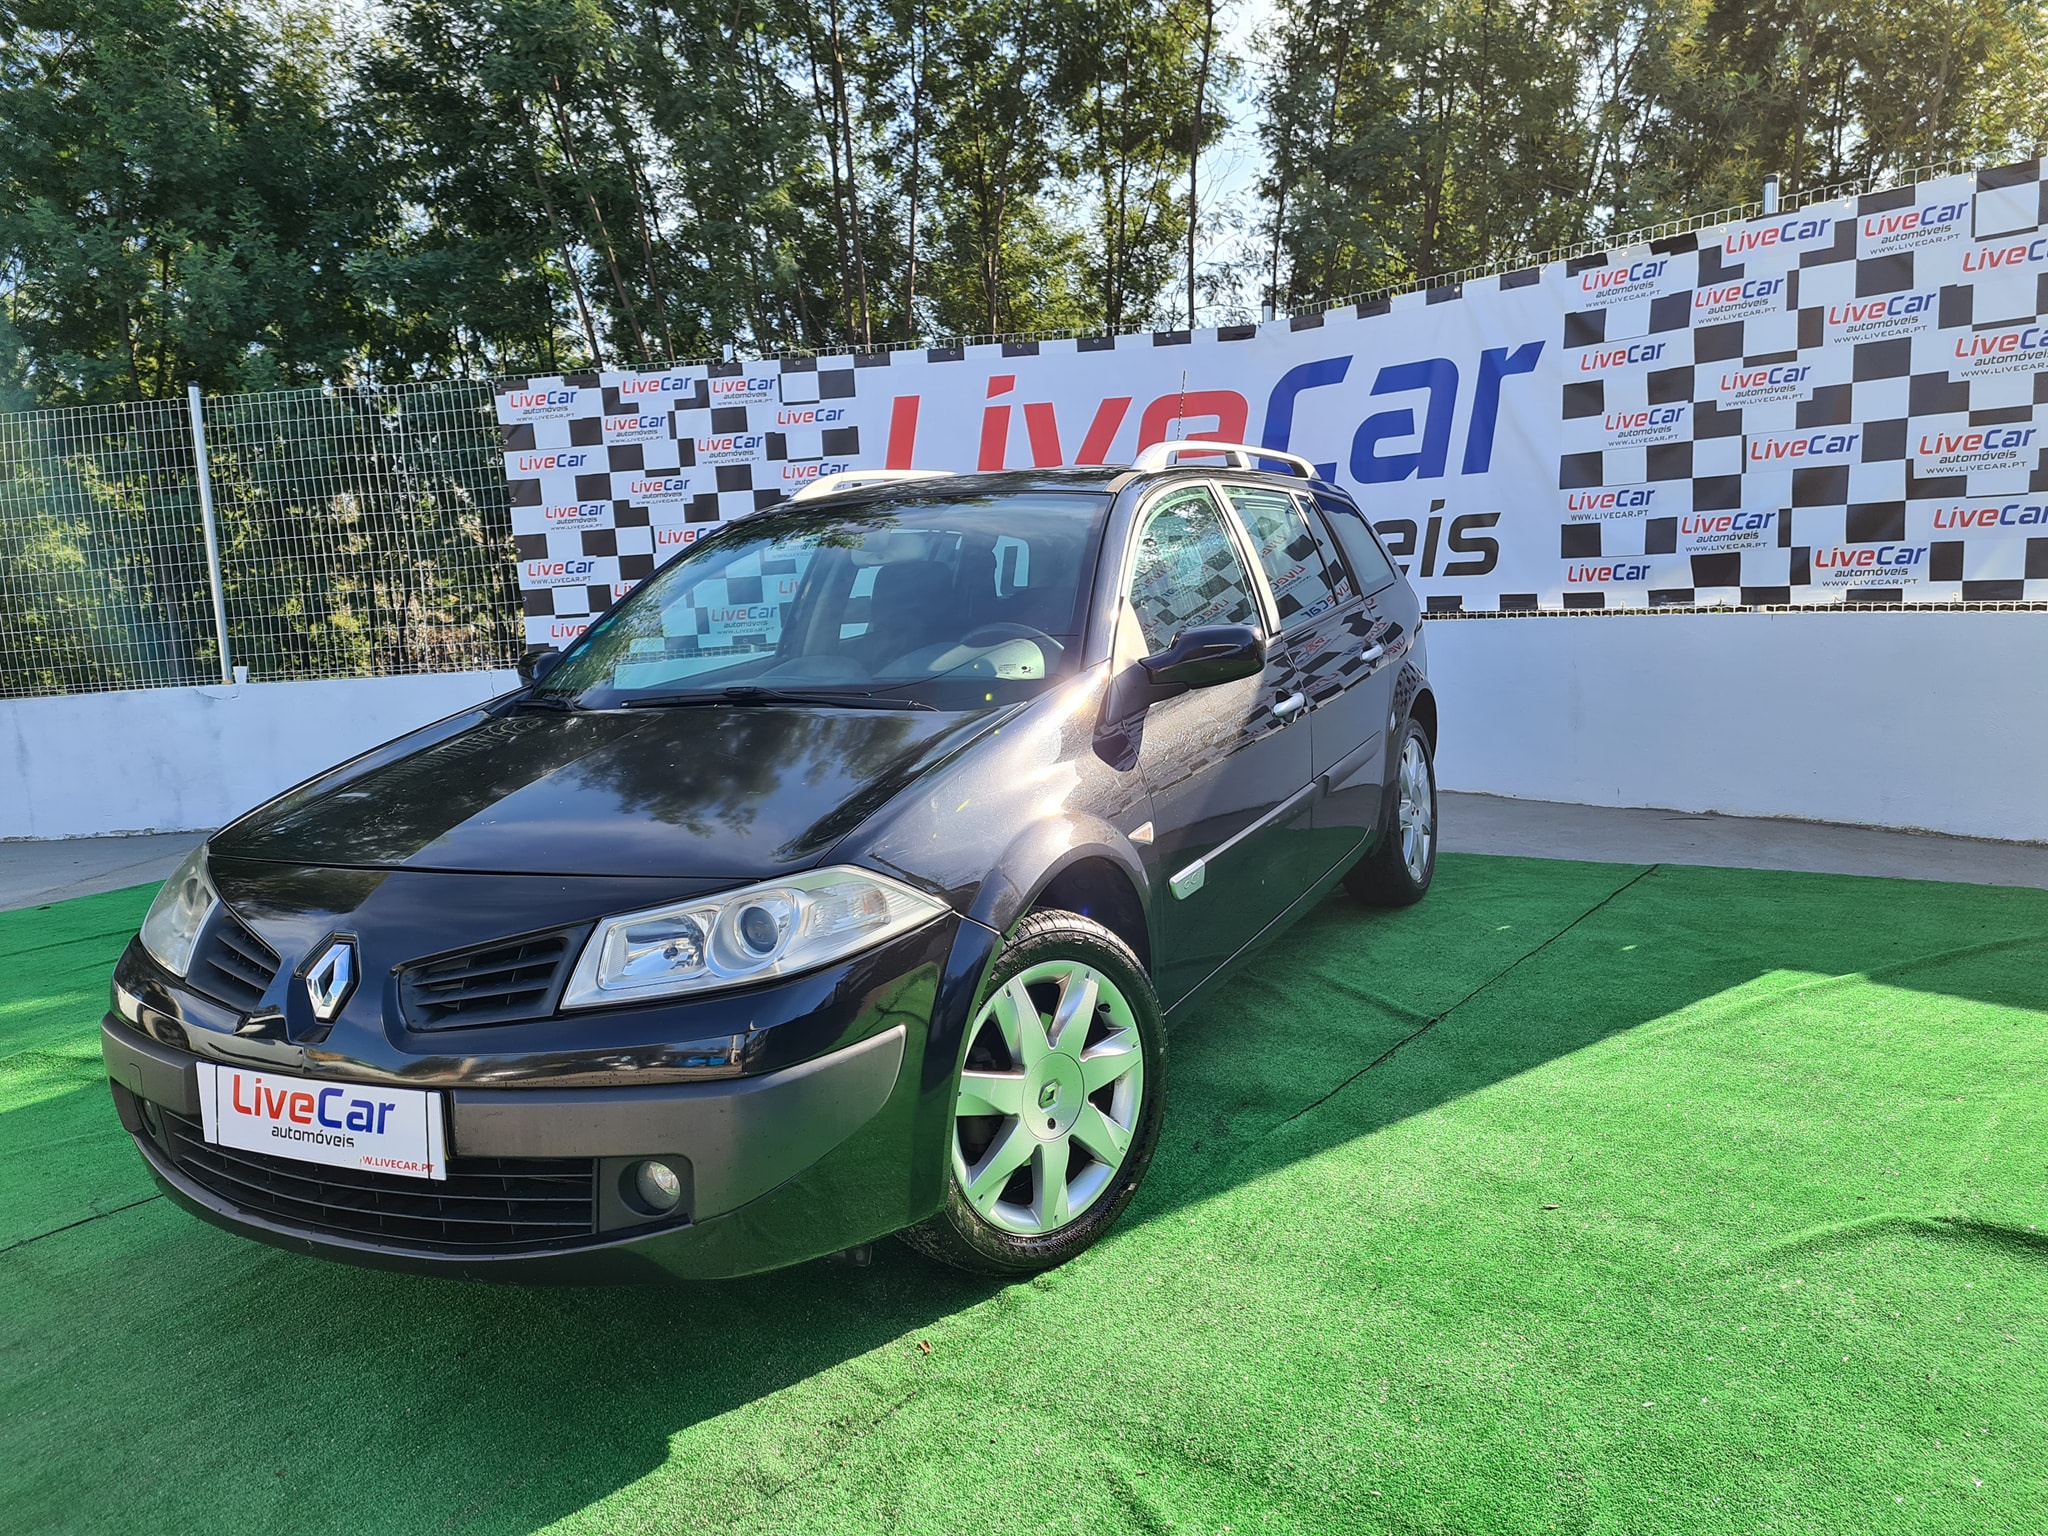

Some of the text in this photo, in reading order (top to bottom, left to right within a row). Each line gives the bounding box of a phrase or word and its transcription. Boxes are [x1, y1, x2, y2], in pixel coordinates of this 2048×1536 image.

[1865, 201, 1968, 237] LiveCar
[1726, 217, 1831, 254] LiveCar
[1881, 223, 1951, 245] automóveis
[1869, 233, 1960, 255] WWW.LIVECAR.PT
[1962, 239, 2048, 272] LiveC
[1582, 259, 1668, 291] LiveCar
[1596, 280, 1654, 299] automóveis
[1695, 278, 1784, 308] LiveCar
[1585, 289, 1661, 308] WWW.LIVECAR.PT
[1708, 298, 1769, 315] automóveis
[1698, 307, 1777, 324] WWW.LIVECAR.PT
[1829, 293, 1936, 325] LiveCar
[1846, 315, 1918, 334] automóveis
[1833, 325, 1927, 344] WWW.LIVECAR.PT
[1580, 342, 1666, 371] LiveCar
[1974, 349, 2048, 367] automóvei
[1961, 362, 2048, 378] WWW.LIVECAR.
[622, 377, 692, 394] LiveCar
[712, 378, 776, 393] LiveCar
[1721, 366, 1811, 391] LiveCar
[510, 390, 577, 408] LiveCar
[723, 391, 767, 400] automóveis
[1735, 384, 1796, 398] automóveis
[1725, 393, 1804, 407] WWW.LIVECAR.PT
[515, 412, 576, 422] WWW.LIVECAR.PT
[522, 405, 569, 415] automóveis
[777, 408, 845, 424] LiveCar
[885, 341, 1546, 483] LiveCar
[604, 416, 666, 431] LiveCar
[1604, 406, 1685, 431] LiveCar
[616, 429, 658, 437] automóveis
[1617, 425, 1672, 438] automóveis
[698, 435, 763, 451] LiveCar
[1608, 433, 1679, 447] WWW.LIVECAR.PT
[1750, 434, 1859, 460] LiveCar
[1919, 428, 2037, 455] LiveCar
[519, 453, 587, 471] LiveCar
[702, 457, 760, 465] WWW.LIVECAR.PT
[709, 450, 754, 458] automóveis
[1939, 450, 2017, 465] automóveis
[783, 463, 849, 479] LiveCar
[1926, 461, 2028, 474] WWW.LIVECAR.PT
[631, 479, 690, 493] LiveCar
[642, 491, 682, 499] automóveis
[1568, 489, 1655, 511] LiveCar
[545, 503, 605, 519] LiveCar
[1570, 509, 1649, 522] WWW.LIVECAR.PT
[556, 517, 597, 525] automóveis
[1681, 512, 1775, 534] LiveCar
[658, 528, 713, 544] LiveC
[1696, 530, 1759, 543] automóveis
[1685, 541, 1767, 553] WWW.LIVECAR.PT
[1814, 546, 1928, 568] LiveCar
[528, 560, 595, 577] LiveCar
[1567, 563, 1651, 583] LiveCar
[1834, 566, 1908, 578] automóveis
[530, 575, 591, 585] WWW.LIVECAR.PT
[1822, 578, 1918, 587] WWW.LIVECAR.PT
[711, 606, 777, 622] LiveCar
[551, 623, 588, 638] Live
[233, 1074, 396, 1135] LiveCar
[271, 1125, 355, 1148] automóveis
